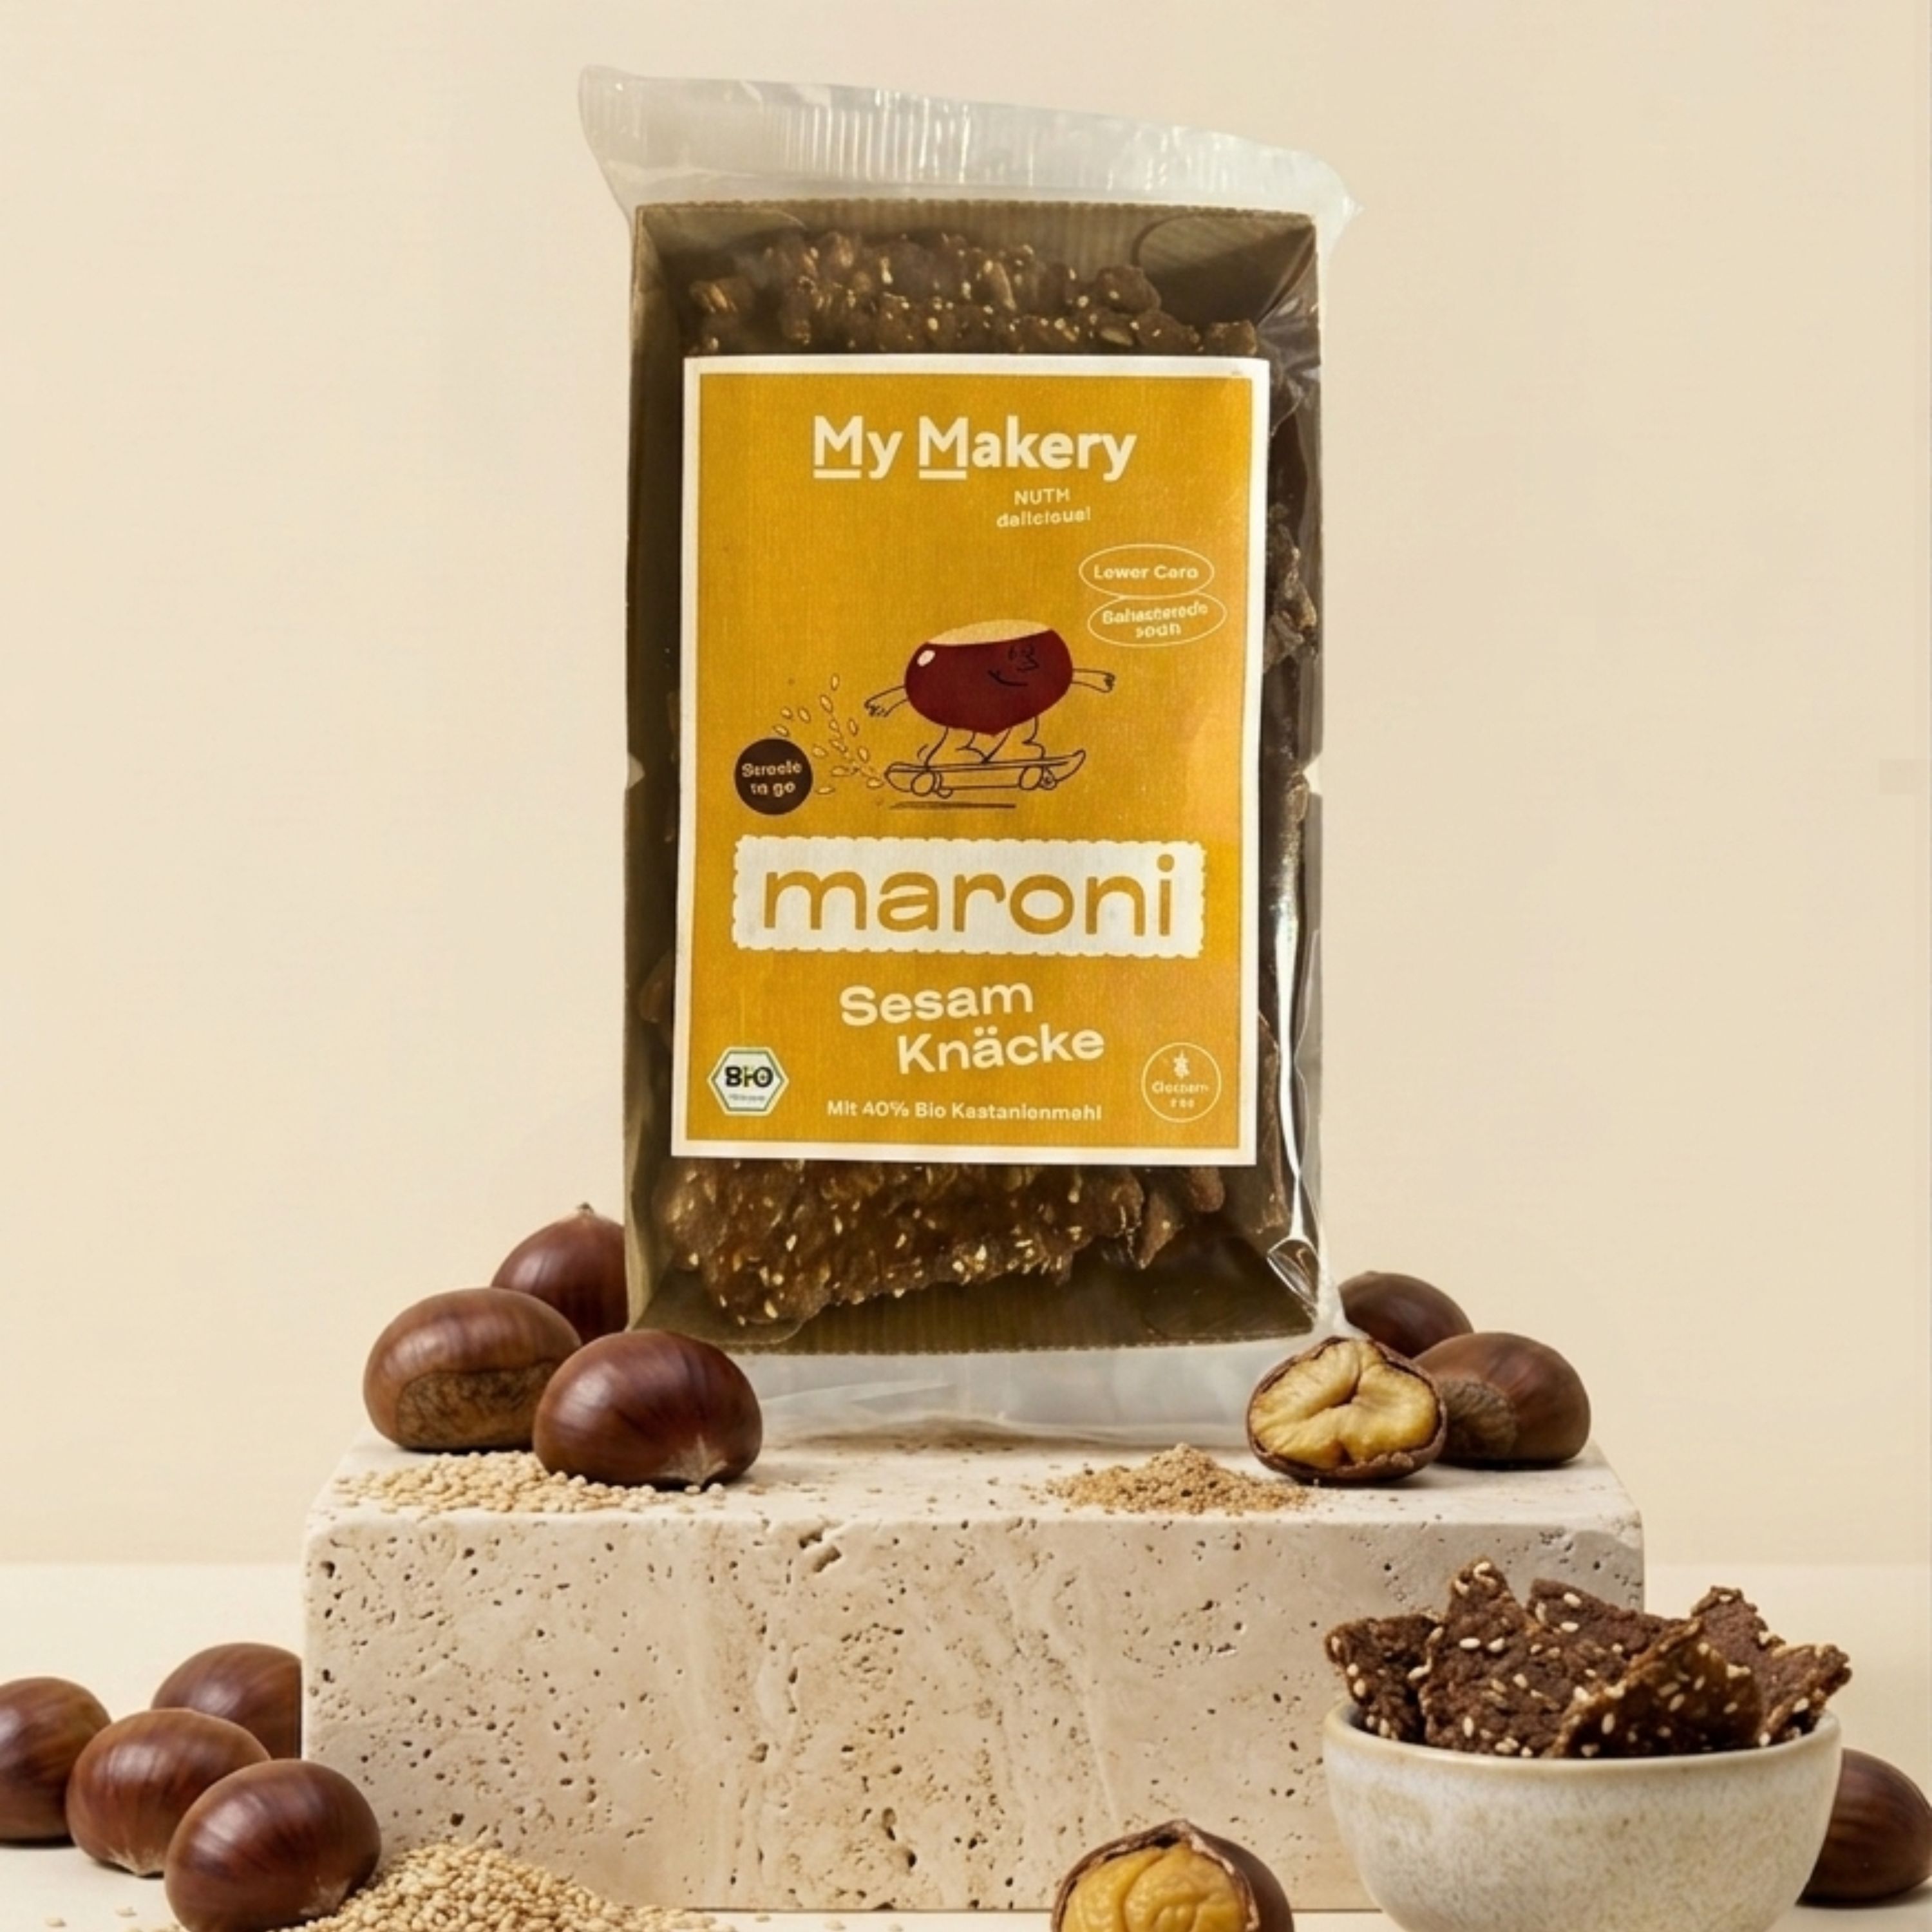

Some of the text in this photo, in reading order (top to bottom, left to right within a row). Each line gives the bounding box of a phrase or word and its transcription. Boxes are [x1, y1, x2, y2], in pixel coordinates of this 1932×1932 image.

[813, 415, 1136, 482] My Makery
[764, 853, 1176, 936] maroni
[840, 982, 1033, 1026] Sesam
[898, 1023, 1104, 1074] Knäcke
[827, 1100, 858, 1116] Mit
[862, 1101, 909, 1117] 40%
[914, 1101, 947, 1119] Bio
